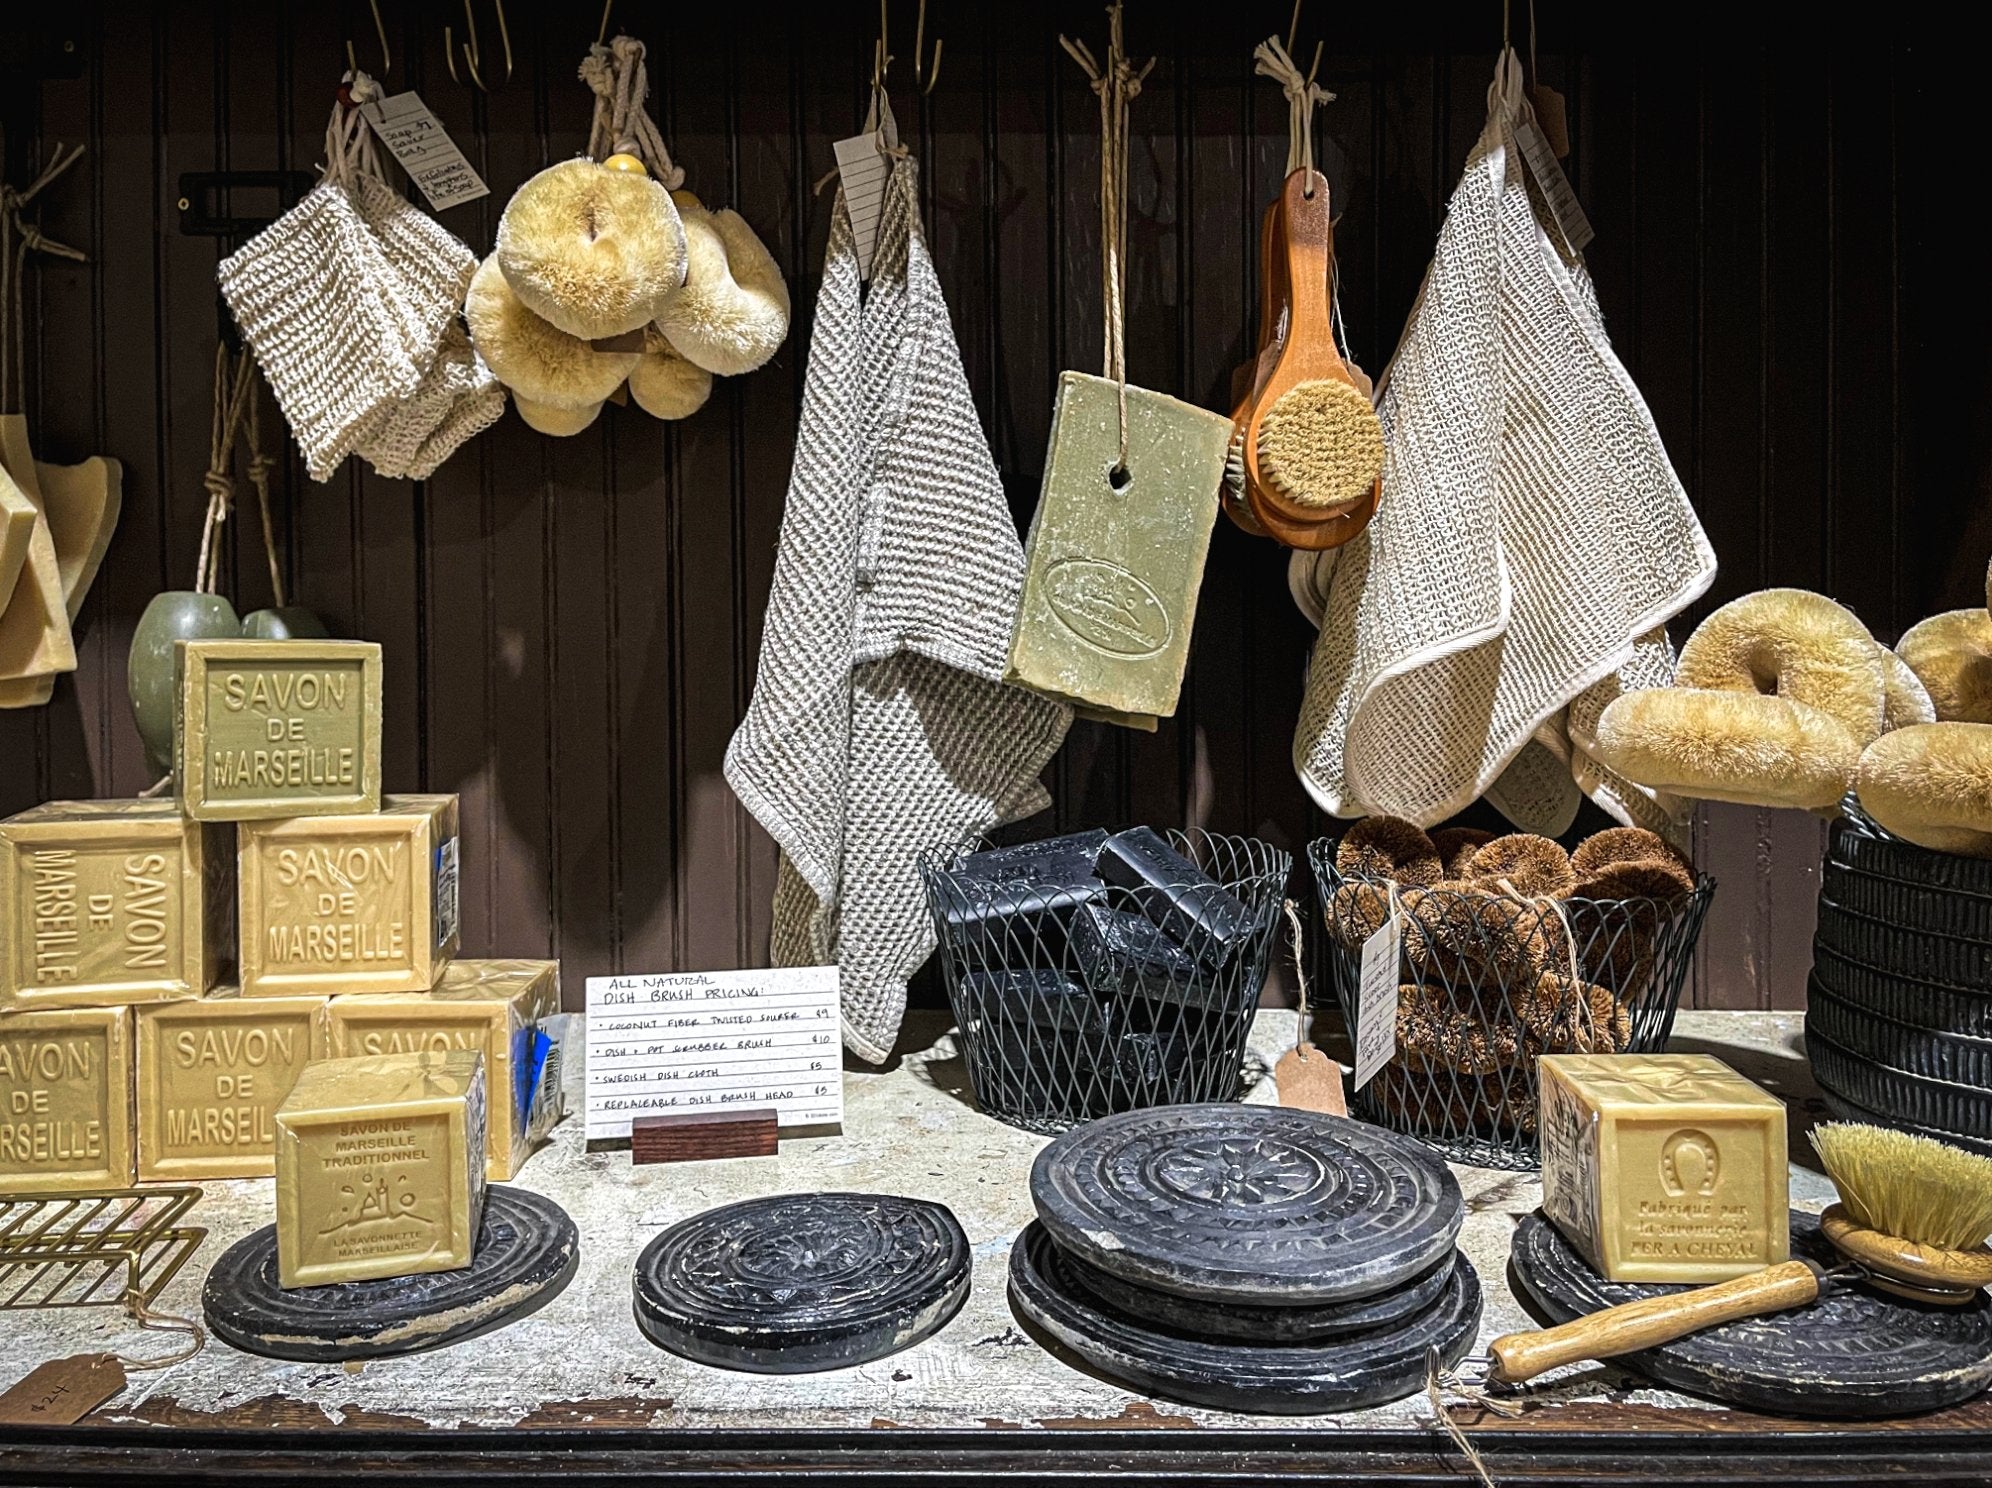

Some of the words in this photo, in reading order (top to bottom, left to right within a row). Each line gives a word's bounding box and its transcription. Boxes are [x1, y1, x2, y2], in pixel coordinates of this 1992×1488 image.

[225, 673, 346, 712] SAVON
[267, 718, 304, 741] DE
[214, 748, 352, 788] MARSEILLE
[279, 847, 395, 886] SAVON
[88, 894, 113, 931] DE
[124, 854, 167, 969] SAVON
[318, 892, 356, 917] DE
[34, 850, 79, 983] MARSEILLE
[269, 922, 403, 962] MARSEILLE
[609, 979, 637, 990] ALL
[643, 975, 715, 988] NATURAL
[604, 991, 635, 1005] DISH
[651, 988, 693, 1002] BRUSH
[668, 1018, 699, 1028] FIBER
[177, 1028, 293, 1069] SAVON
[364, 1032, 476, 1055] SAVON
[605, 1048, 626, 1057] DISH
[737, 1038, 772, 1049] BRUSH
[812, 1034, 830, 1044] $10
[0, 1041, 90, 1082] AVON
[603, 1073, 646, 1084] SWEDISH
[658, 1071, 679, 1080] DISH
[688, 1068, 719, 1078] CLOTH
[810, 1062, 822, 1071] $5
[217, 1074, 254, 1099] DE
[689, 1095, 711, 1105] DISH
[721, 1091, 756, 1102] BRUSH
[765, 1091, 793, 1100] HEAD
[815, 1085, 828, 1096] $5
[12, 1090, 50, 1114] DE
[167, 1105, 274, 1147] MARSEIL
[340, 1122, 388, 1137] SAVON
[392, 1121, 411, 1132] DE
[0, 1120, 100, 1162] RSEILLE
[335, 1135, 416, 1152] MARSEILLE
[322, 1149, 431, 1168] TRADITIONNEL
[333, 1238, 349, 1247] LA
[350, 1231, 422, 1245] SAVONNETTE
[1660, 1221, 1748, 1236] savonnerie
[339, 1241, 419, 1257] MARSEILLAISE
[1631, 1241, 1663, 1255] FER
[1687, 1241, 1757, 1257] CHEVAL
[31, 1385, 70, 1412] $24
